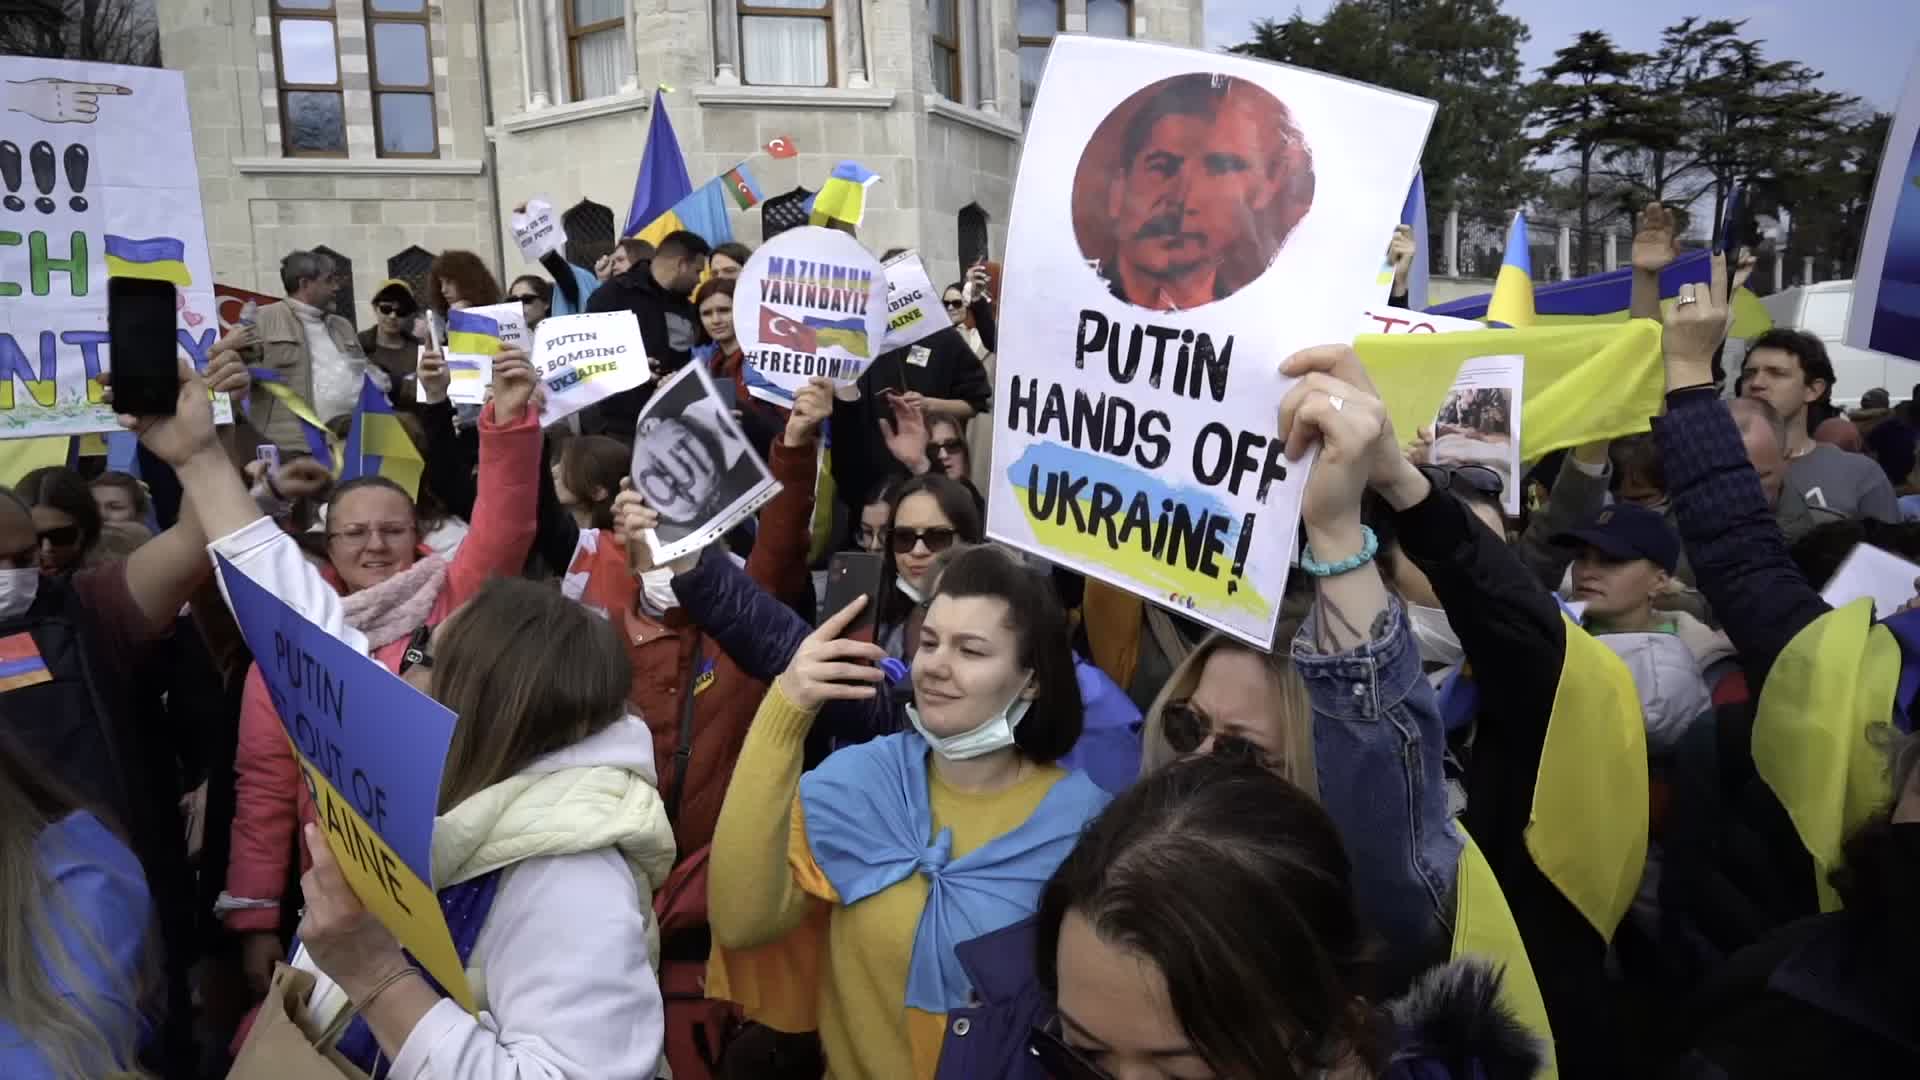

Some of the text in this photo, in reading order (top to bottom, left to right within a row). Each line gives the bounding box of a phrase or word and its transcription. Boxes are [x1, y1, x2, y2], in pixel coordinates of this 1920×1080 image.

[768, 256, 871, 291] MAZLUMUN
[545, 332, 597, 351] PUTIN
[547, 345, 626, 372] BOMBING
[745, 350, 861, 380] #FREEDOMUA
[1075, 309, 1234, 402] PUTIN
[547, 361, 617, 392] UKRAINE
[1008, 375, 1287, 504] HANDS OFF
[1028, 464, 1256, 596] UKRAINE!
[274, 631, 344, 728] PUTIN
[295, 711, 387, 833] OUT OF
